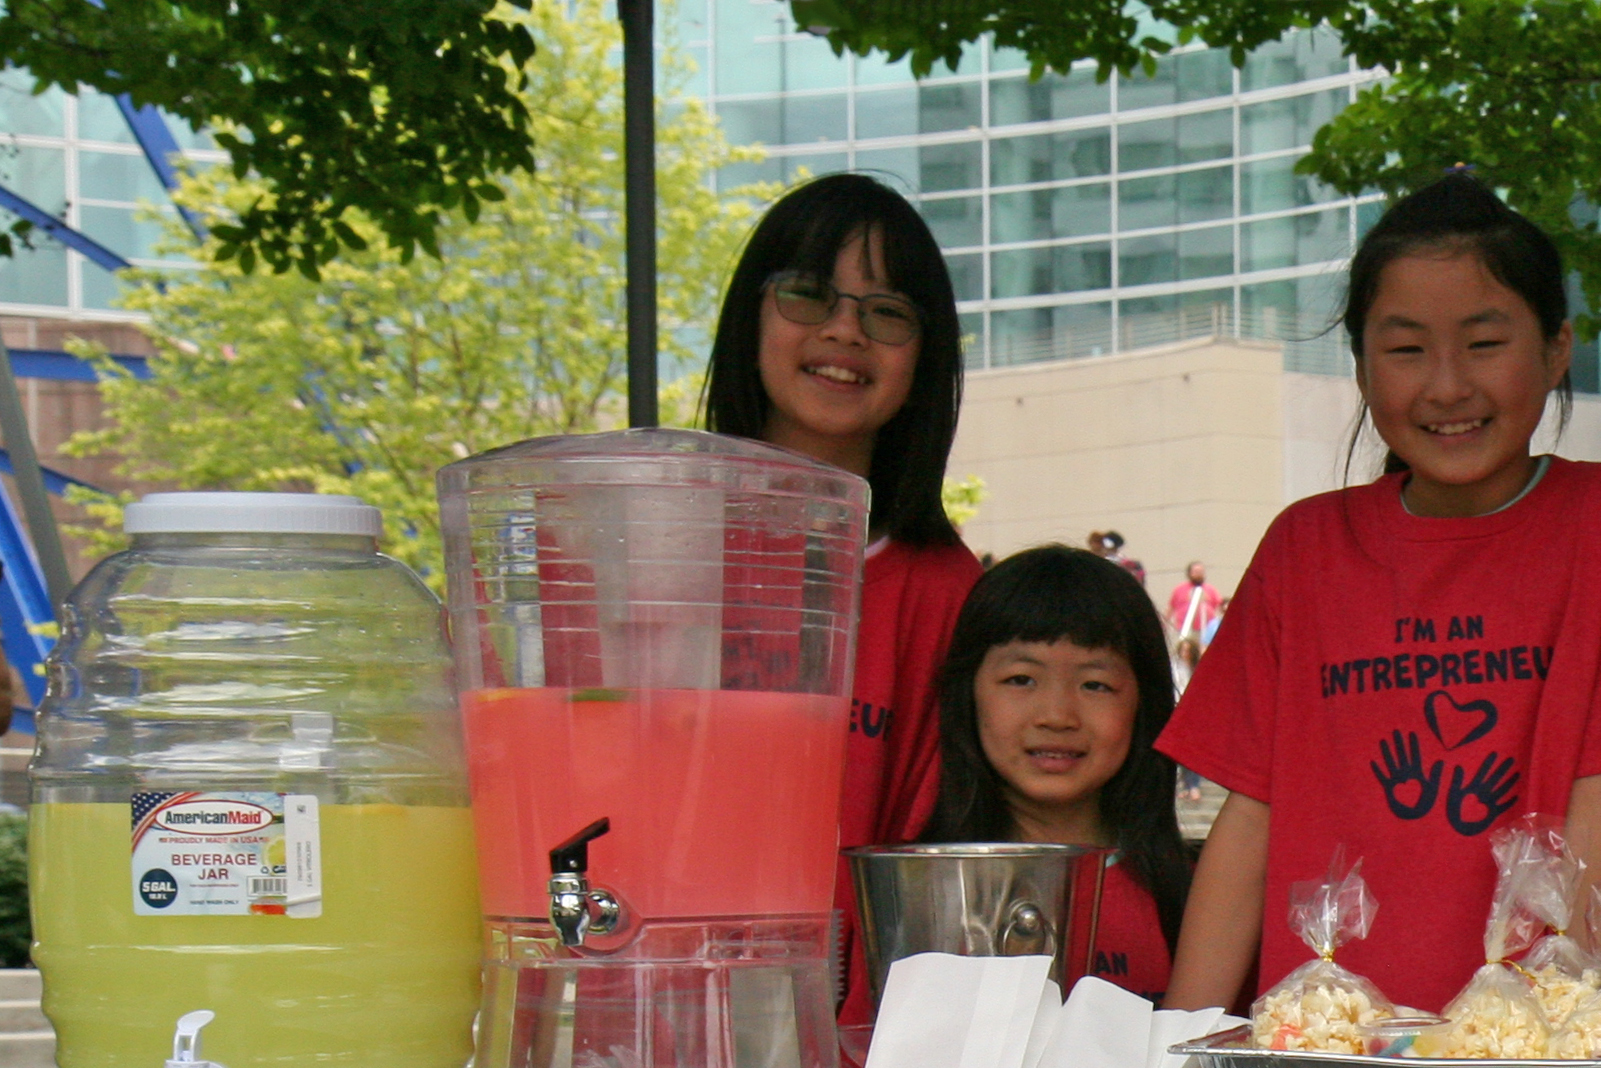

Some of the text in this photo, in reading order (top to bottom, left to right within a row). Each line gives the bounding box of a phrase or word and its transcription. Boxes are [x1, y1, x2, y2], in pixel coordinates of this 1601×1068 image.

[1394, 614, 1484, 643] I'M AN
[164, 810, 262, 825] AmericanMaid
[171, 853, 257, 866] BEVERAGE
[197, 868, 230, 880] JAR
